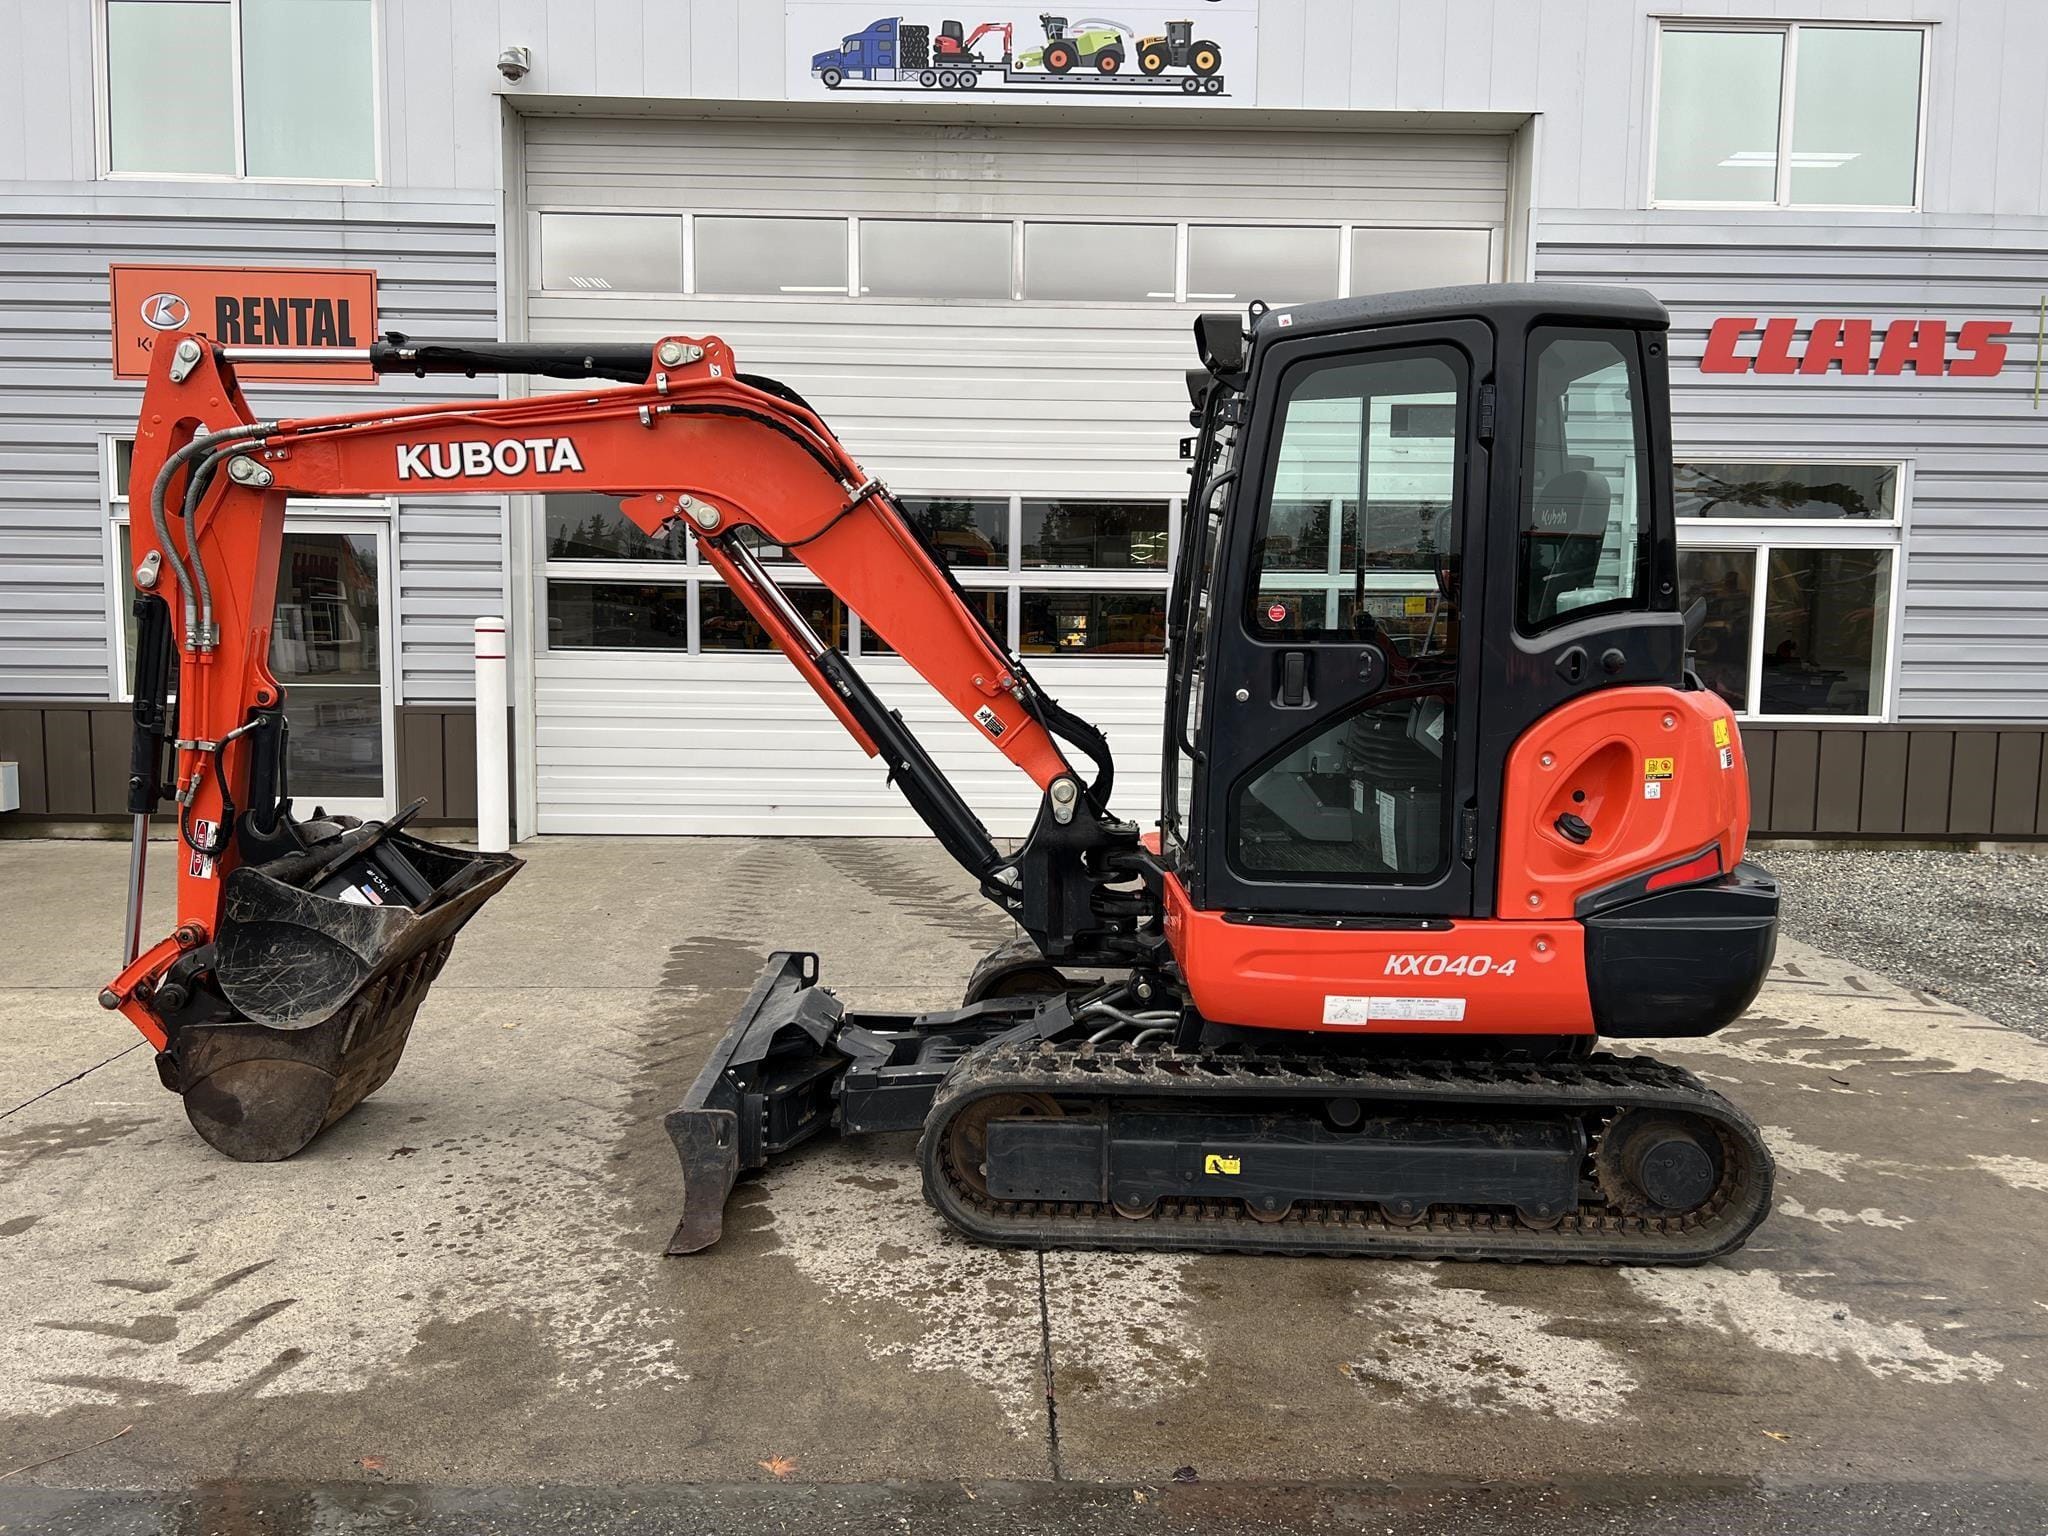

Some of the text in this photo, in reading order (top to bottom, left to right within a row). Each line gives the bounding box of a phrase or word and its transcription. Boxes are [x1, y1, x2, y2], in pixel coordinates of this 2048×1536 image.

[215, 296, 357, 347] RENTAL
[1699, 317, 2013, 377] CLAAS
[396, 437, 584, 479] KUBOTA
[195, 833, 205, 864] DAER
[1383, 954, 1517, 977] KX040-4
